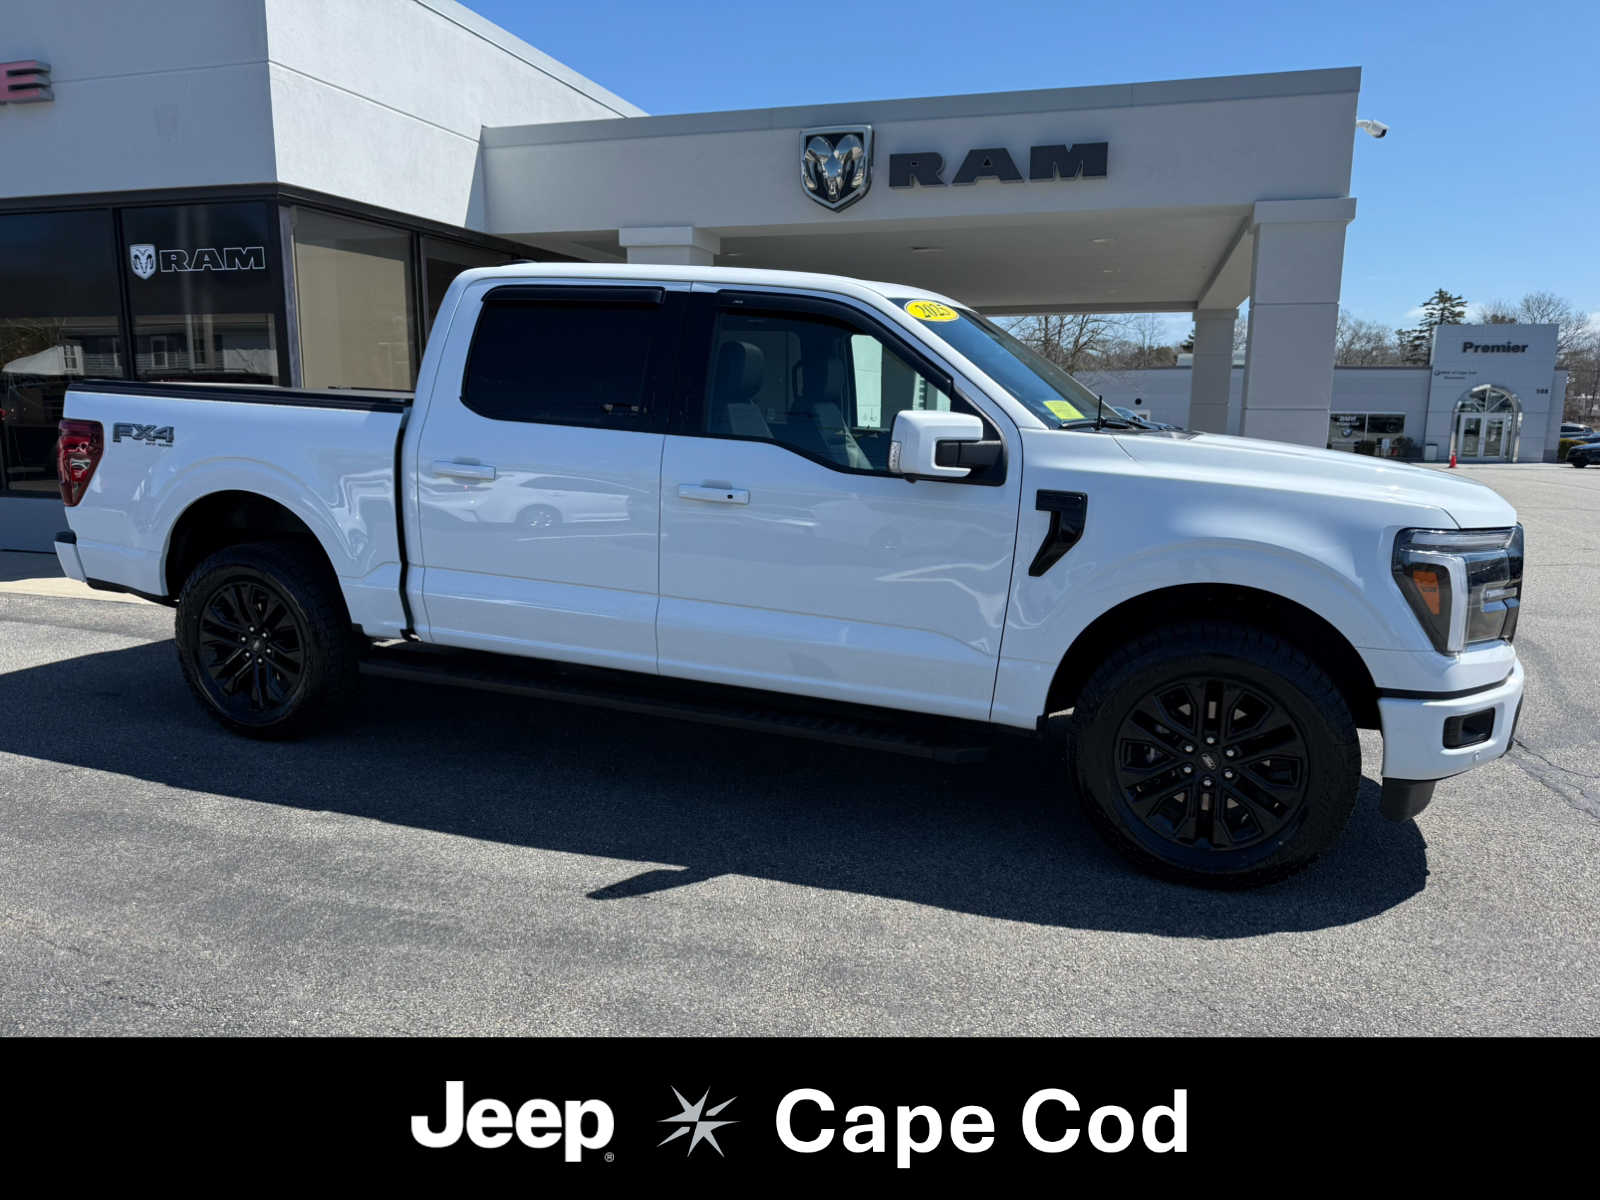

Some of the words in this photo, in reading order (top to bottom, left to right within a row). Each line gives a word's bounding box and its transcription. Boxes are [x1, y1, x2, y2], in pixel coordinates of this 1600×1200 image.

[888, 141, 1109, 188] RAM
[159, 246, 266, 273] RAM
[913, 303, 952, 318] 2025
[1462, 341, 1529, 353] Premier
[112, 422, 175, 443] FX4
